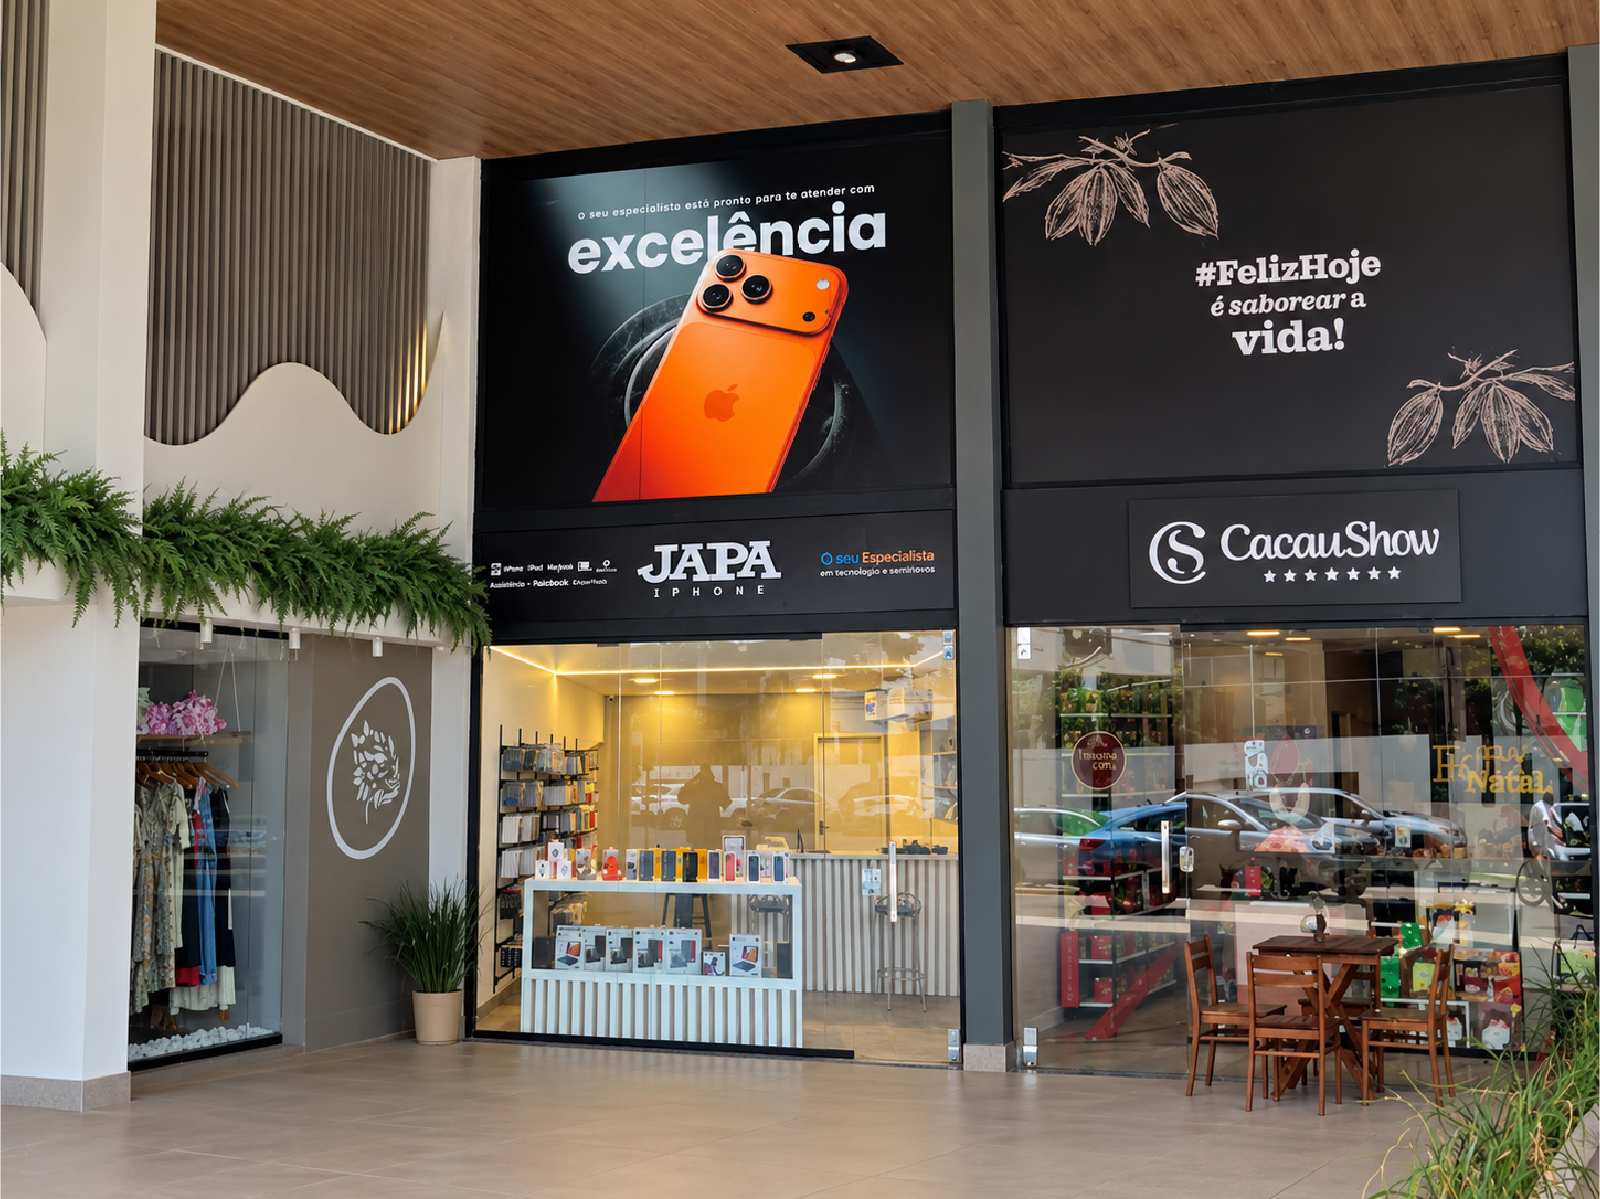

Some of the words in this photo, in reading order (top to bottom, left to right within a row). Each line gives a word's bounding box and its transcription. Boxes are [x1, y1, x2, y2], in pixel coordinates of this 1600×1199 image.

[589, 210, 609, 220] seu
[612, 202, 681, 217] especialista
[684, 198, 709, 211] está
[713, 196, 751, 210] pronto
[755, 193, 782, 205] para
[785, 190, 798, 201] te
[800, 185, 846, 200] atender
[849, 183, 876, 195] com
[568, 200, 886, 275] excelência
[1195, 247, 1382, 287] #FelizHoje
[1210, 294, 1225, 317] é
[1227, 292, 1347, 316] saborear
[1350, 292, 1367, 308] a
[1231, 317, 1345, 355] vida!
[637, 540, 782, 583] JAPA
[820, 551, 833, 566] O
[835, 554, 859, 565] seu
[862, 549, 935, 566] Especialista
[652, 584, 766, 598] IPHONE
